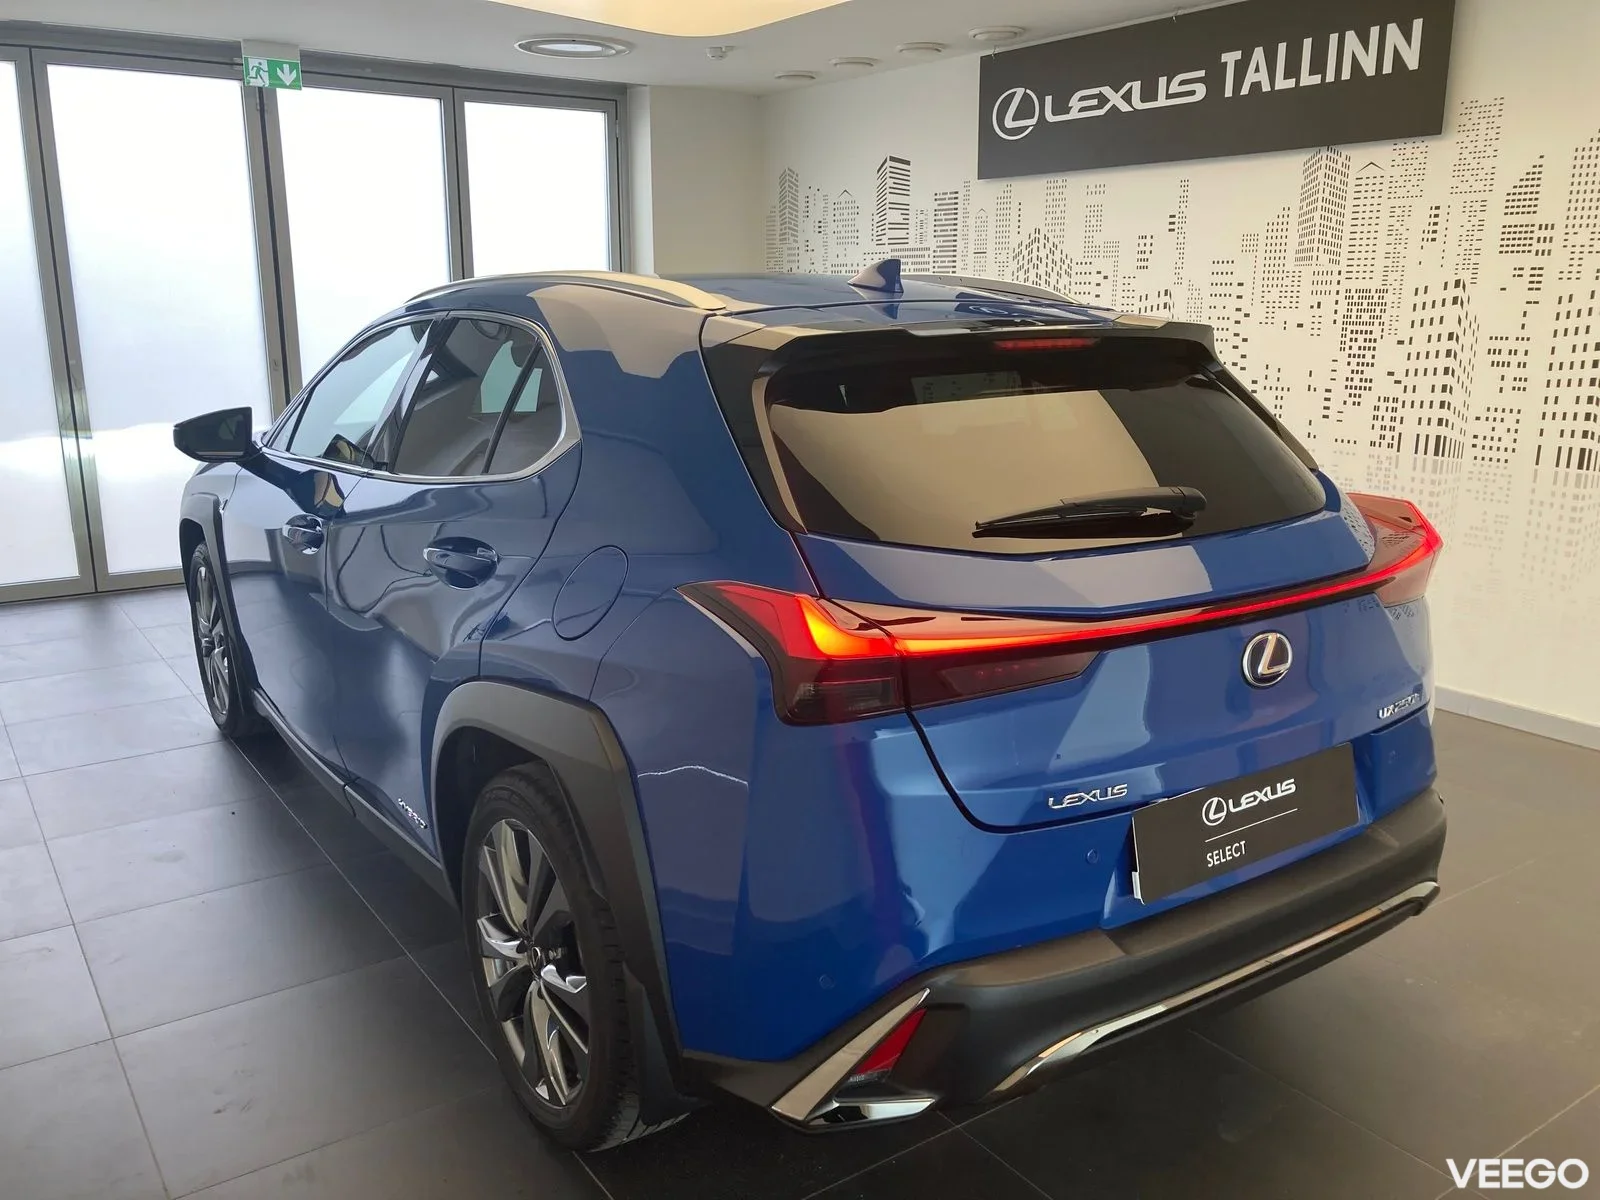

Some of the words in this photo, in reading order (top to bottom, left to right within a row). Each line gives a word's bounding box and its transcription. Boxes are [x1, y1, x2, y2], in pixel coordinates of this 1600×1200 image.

[1045, 70, 1207, 123] LEXUS
[1221, 18, 1424, 98] TALLINN
[1048, 783, 1128, 809] LEXUS
[1228, 778, 1297, 813] LEXUS
[1206, 840, 1246, 868] SELECT
